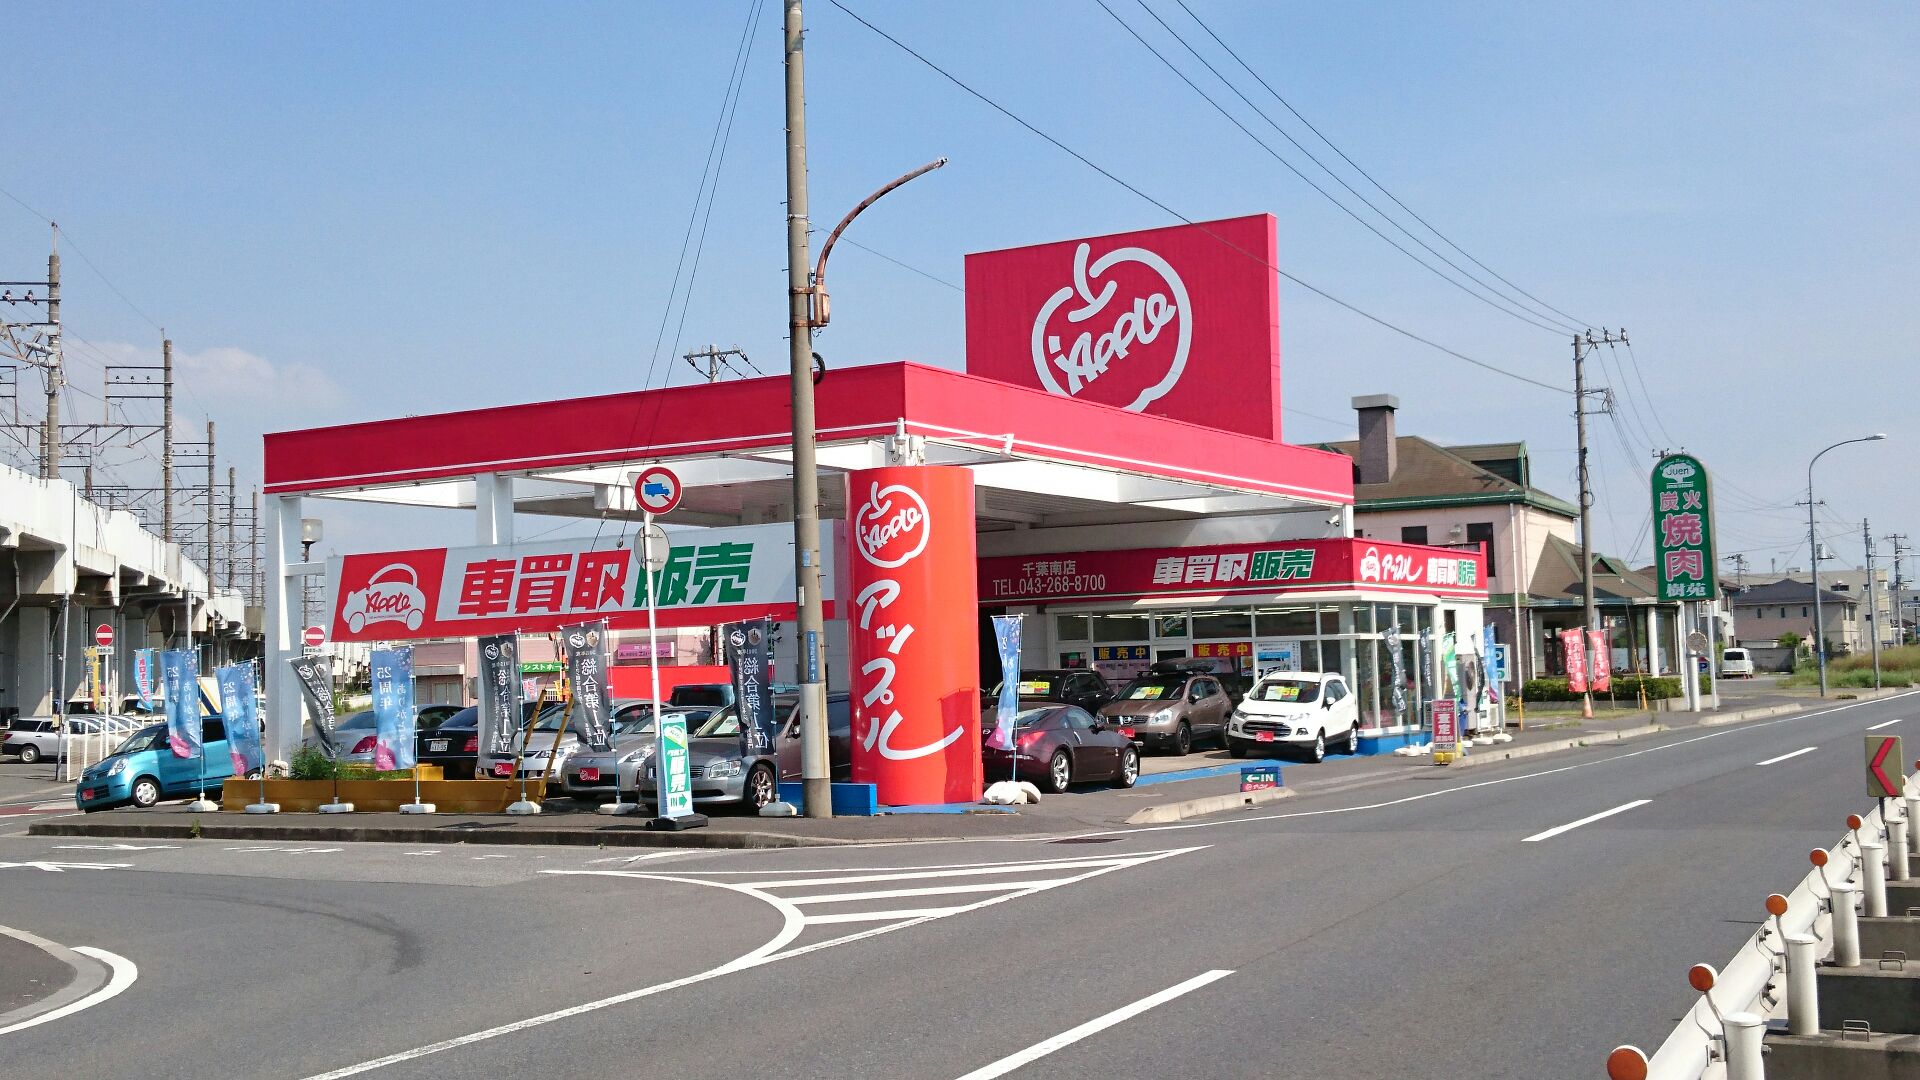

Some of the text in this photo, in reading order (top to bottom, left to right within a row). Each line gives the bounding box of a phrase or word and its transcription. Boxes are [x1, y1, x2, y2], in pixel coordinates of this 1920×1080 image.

[1666, 466, 1690, 476] Juen
[1660, 490, 1702, 512] 炭火
[1662, 512, 1704, 582] 焼肉
[1022, 560, 1076, 577] 千葉南店
[1152, 549, 1316, 584] 車買取販売
[993, 574, 1106, 596] TEL.043-268-8700
[1666, 582, 1707, 597] 樹苑
[1098, 646, 1147, 660] 販売中
[1198, 643, 1250, 657] 販売中
[856, 579, 965, 760] アップル
[1260, 774, 1274, 782] IN
[670, 797, 678, 807] IN
